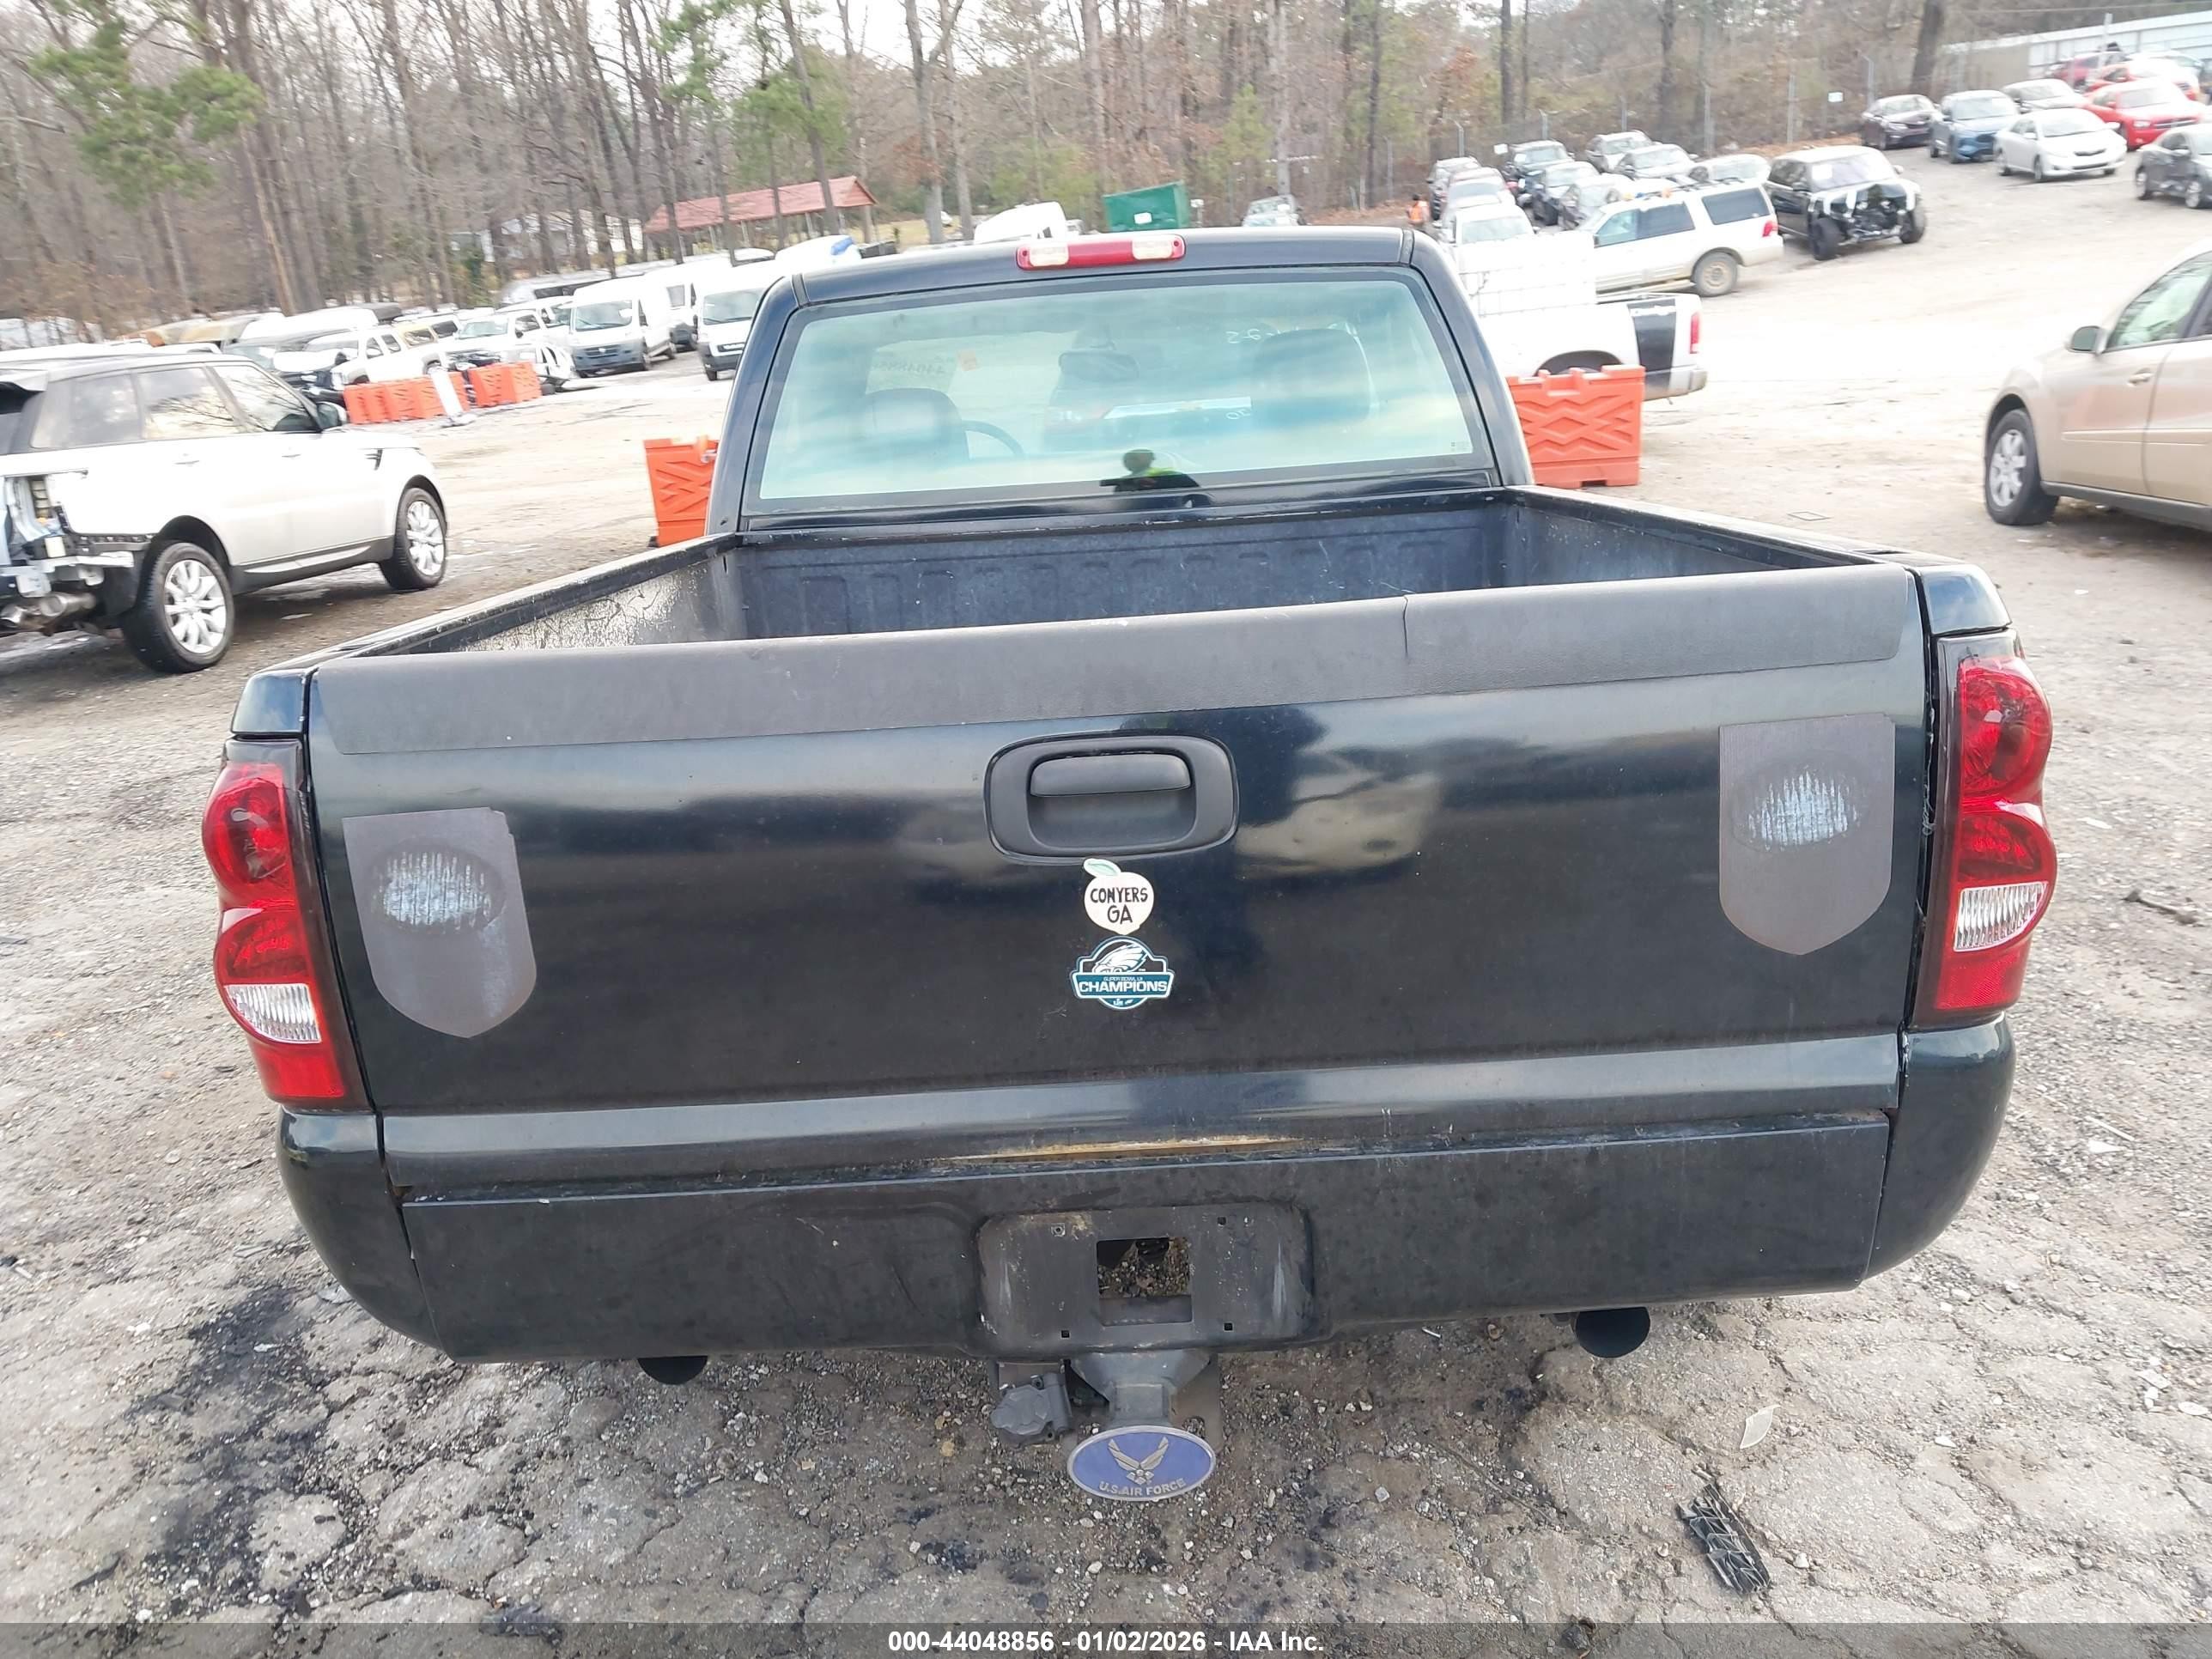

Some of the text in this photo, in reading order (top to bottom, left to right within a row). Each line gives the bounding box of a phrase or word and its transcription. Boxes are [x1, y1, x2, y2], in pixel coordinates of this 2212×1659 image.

[1090, 887, 1148, 903] CONYERS
[1107, 905, 1133, 924] GA
[1079, 981, 1168, 993] CHAMPIONS
[1146, 1477, 1187, 1495] FORCE
